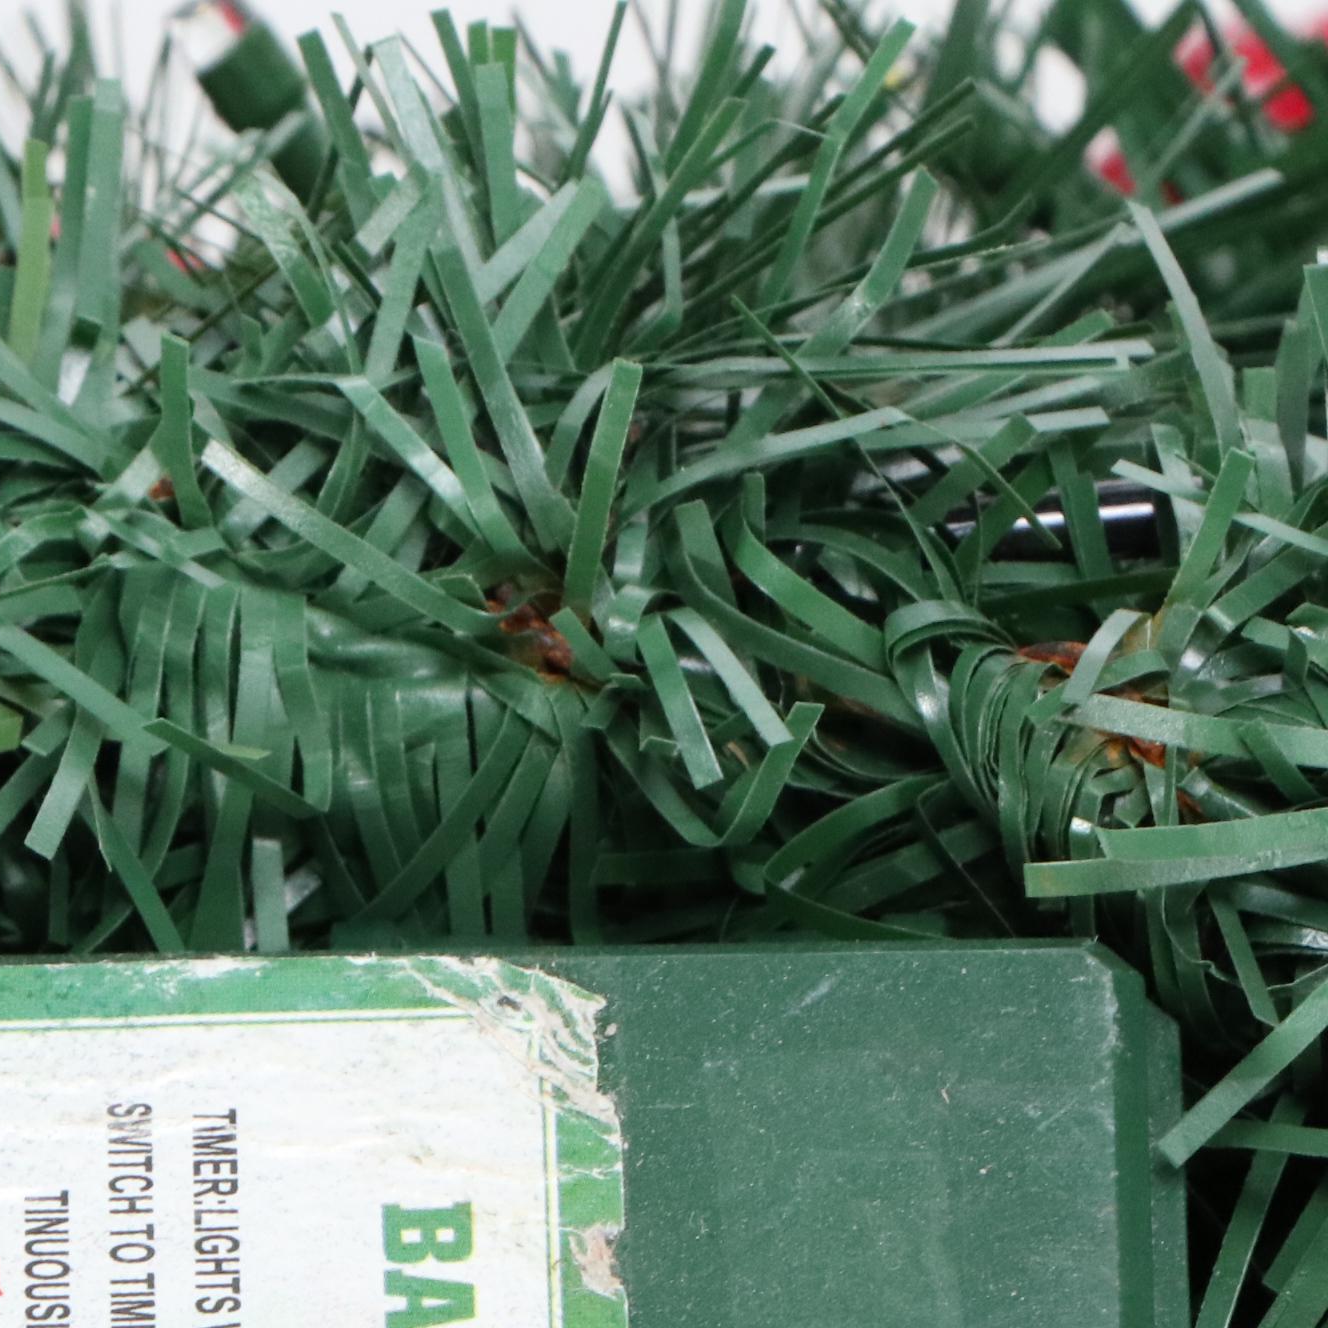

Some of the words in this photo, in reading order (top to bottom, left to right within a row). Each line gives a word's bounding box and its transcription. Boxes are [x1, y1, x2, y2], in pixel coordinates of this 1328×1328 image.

[106, 1103, 154, 1214] SWITCH
[192, 1107, 240, 1315] TIMER:LIGHTS
[107, 1224, 155, 1264] TO
